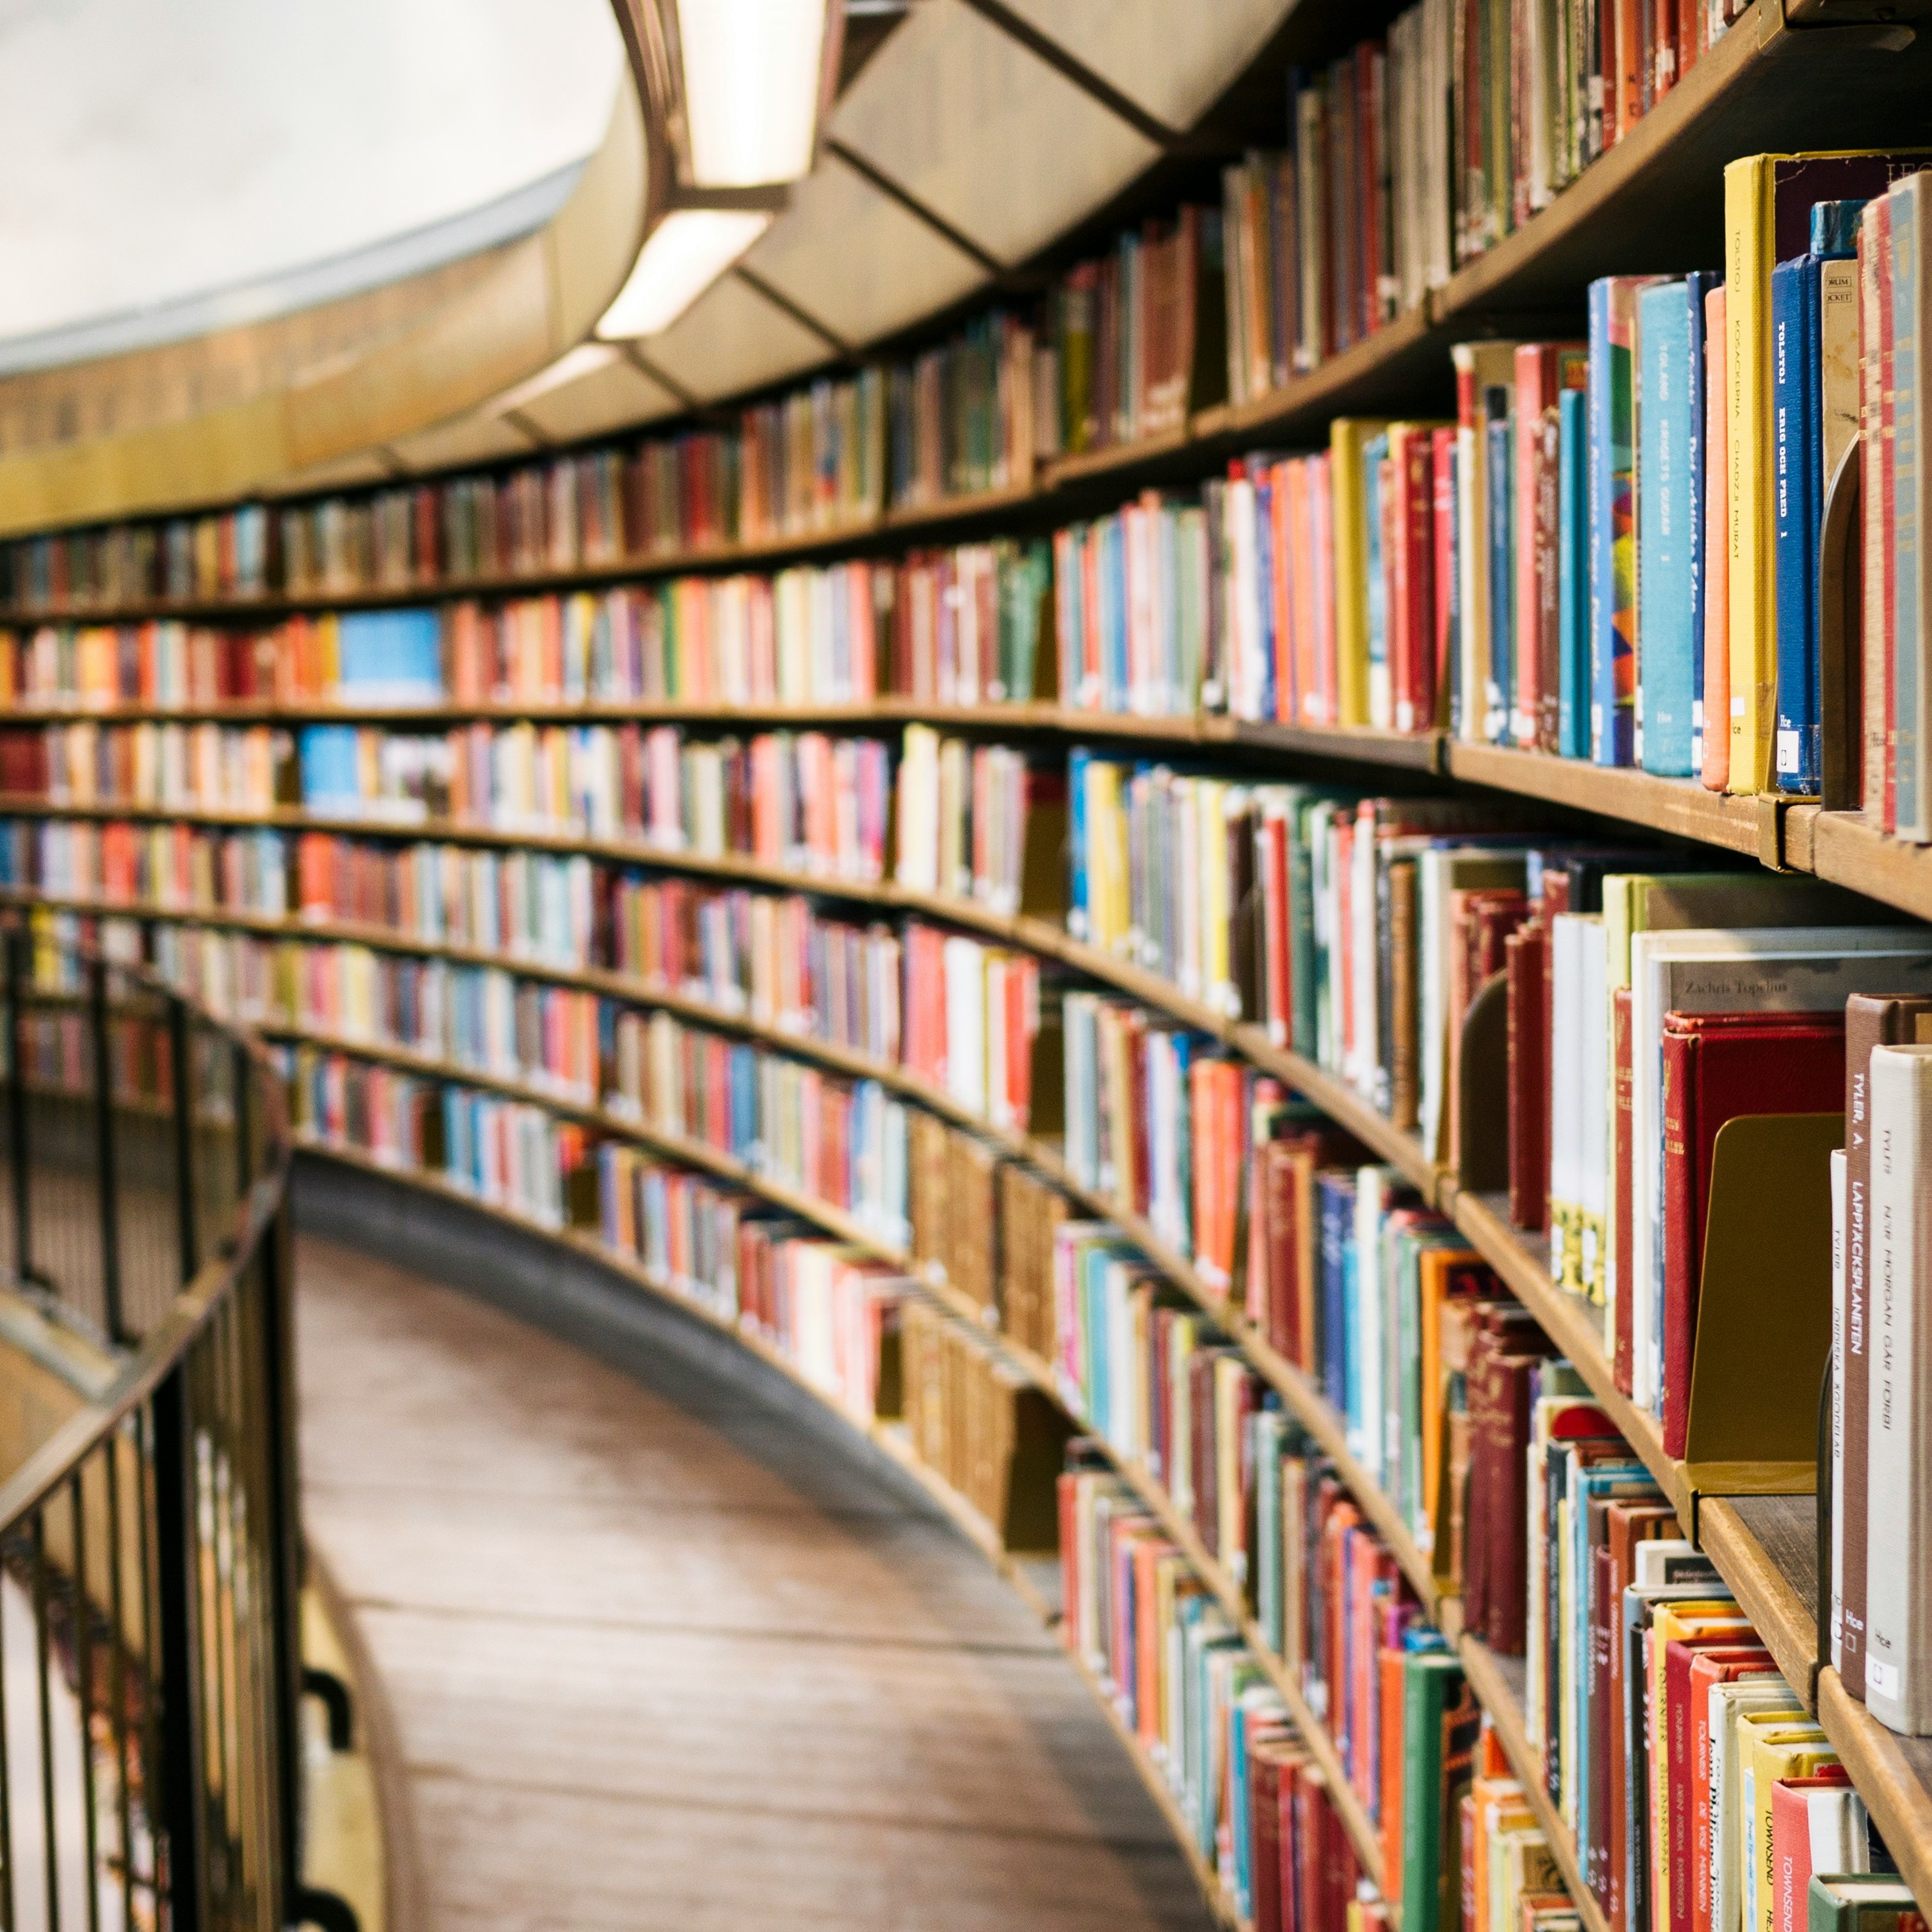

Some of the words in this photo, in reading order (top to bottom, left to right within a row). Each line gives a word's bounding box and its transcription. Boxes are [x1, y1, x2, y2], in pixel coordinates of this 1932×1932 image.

[1659, 344, 1669, 402] TOLAND
[1778, 321, 1786, 385] TOLSTOJ
[1659, 419, 1670, 482] KRIGETS
[1779, 407, 1787, 443] KRIG
[1660, 487, 1670, 537] GUDAR
[1685, 980, 1730, 994] Zachris
[1736, 979, 1788, 997] Topelius
[1883, 1129, 1892, 1174] TYLER
[1850, 1181, 1864, 1355] LAPPTÄCKSPLANETEN
[1883, 1248, 1894, 1327] MORGAN
[1845, 1608, 1865, 1632] Hce
[1659, 1762, 1668, 1877] GULDDROPPEN
[1765, 1810, 1774, 1886] TOWNSEND
[1782, 1856, 1793, 1932] TOWNSEND
